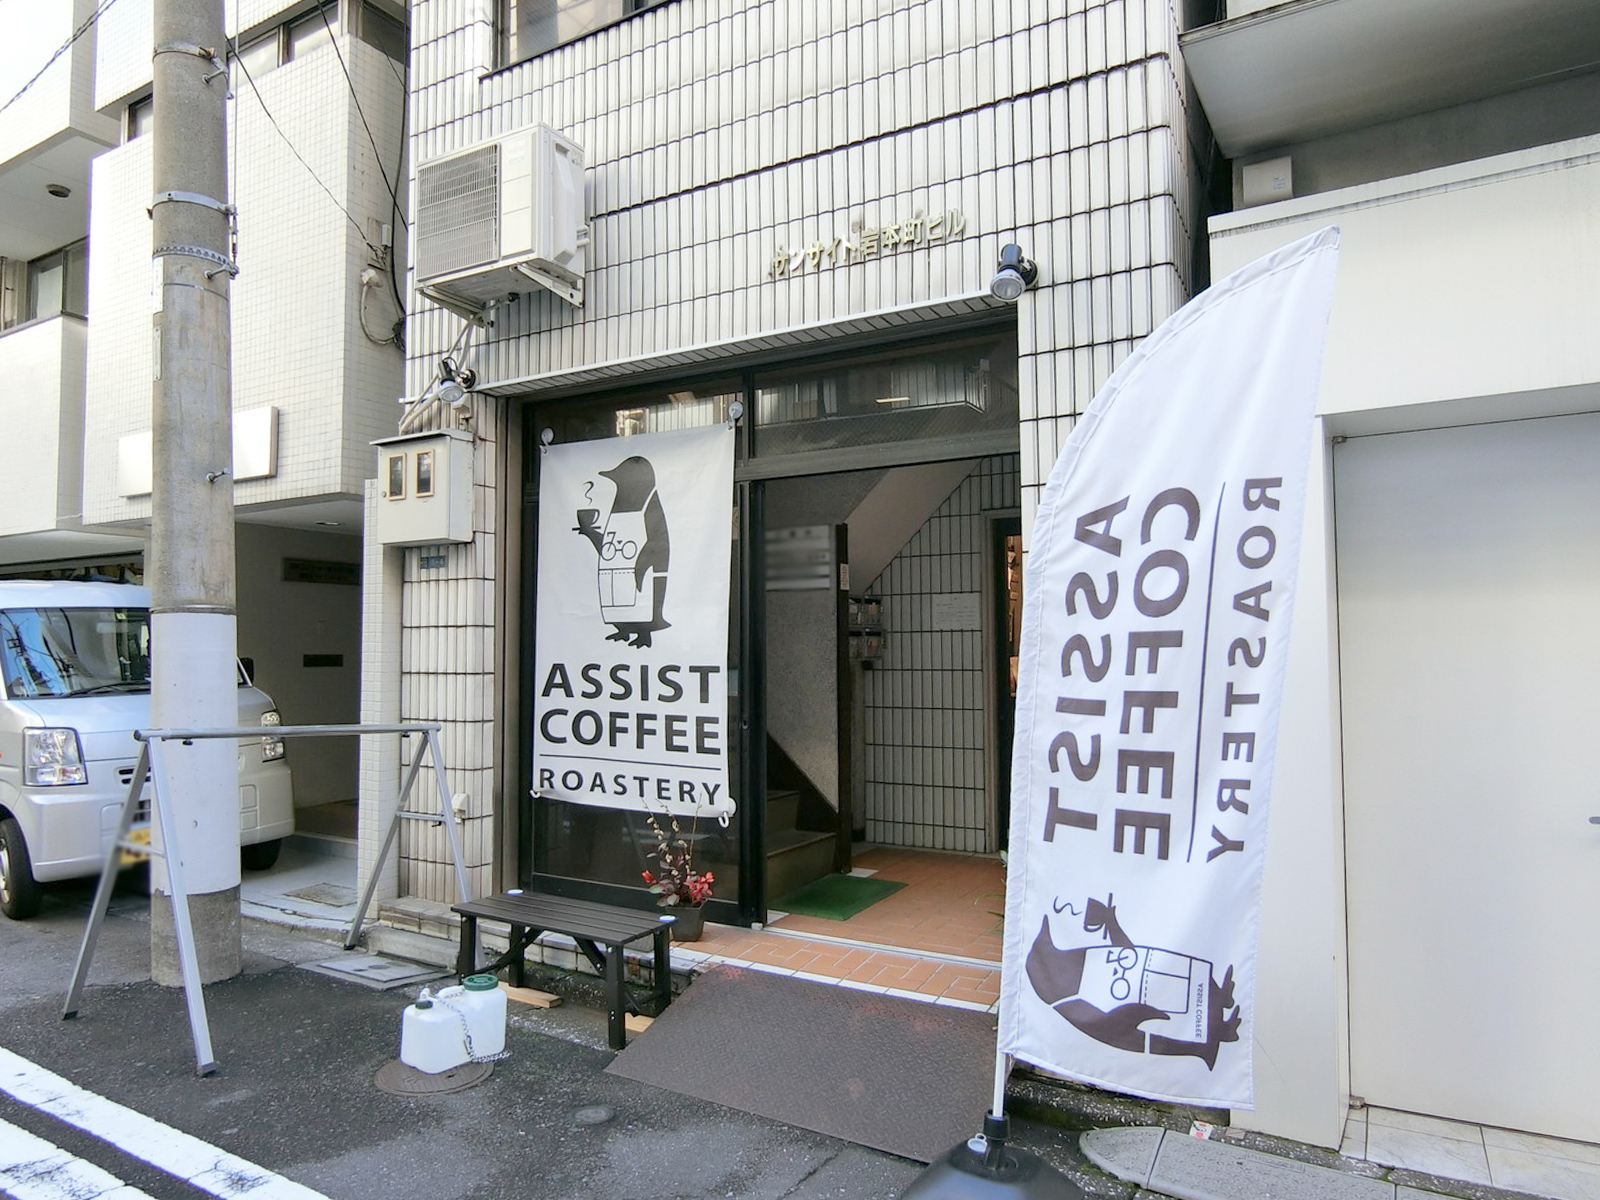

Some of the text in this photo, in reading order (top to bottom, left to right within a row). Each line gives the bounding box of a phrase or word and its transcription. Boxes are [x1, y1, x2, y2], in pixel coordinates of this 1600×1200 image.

[772, 209, 966, 275] サンサイト岩本町ビル
[541, 663, 721, 704] ASSIST
[540, 708, 721, 755] COFFEE
[540, 768, 721, 806] ROASTERY
